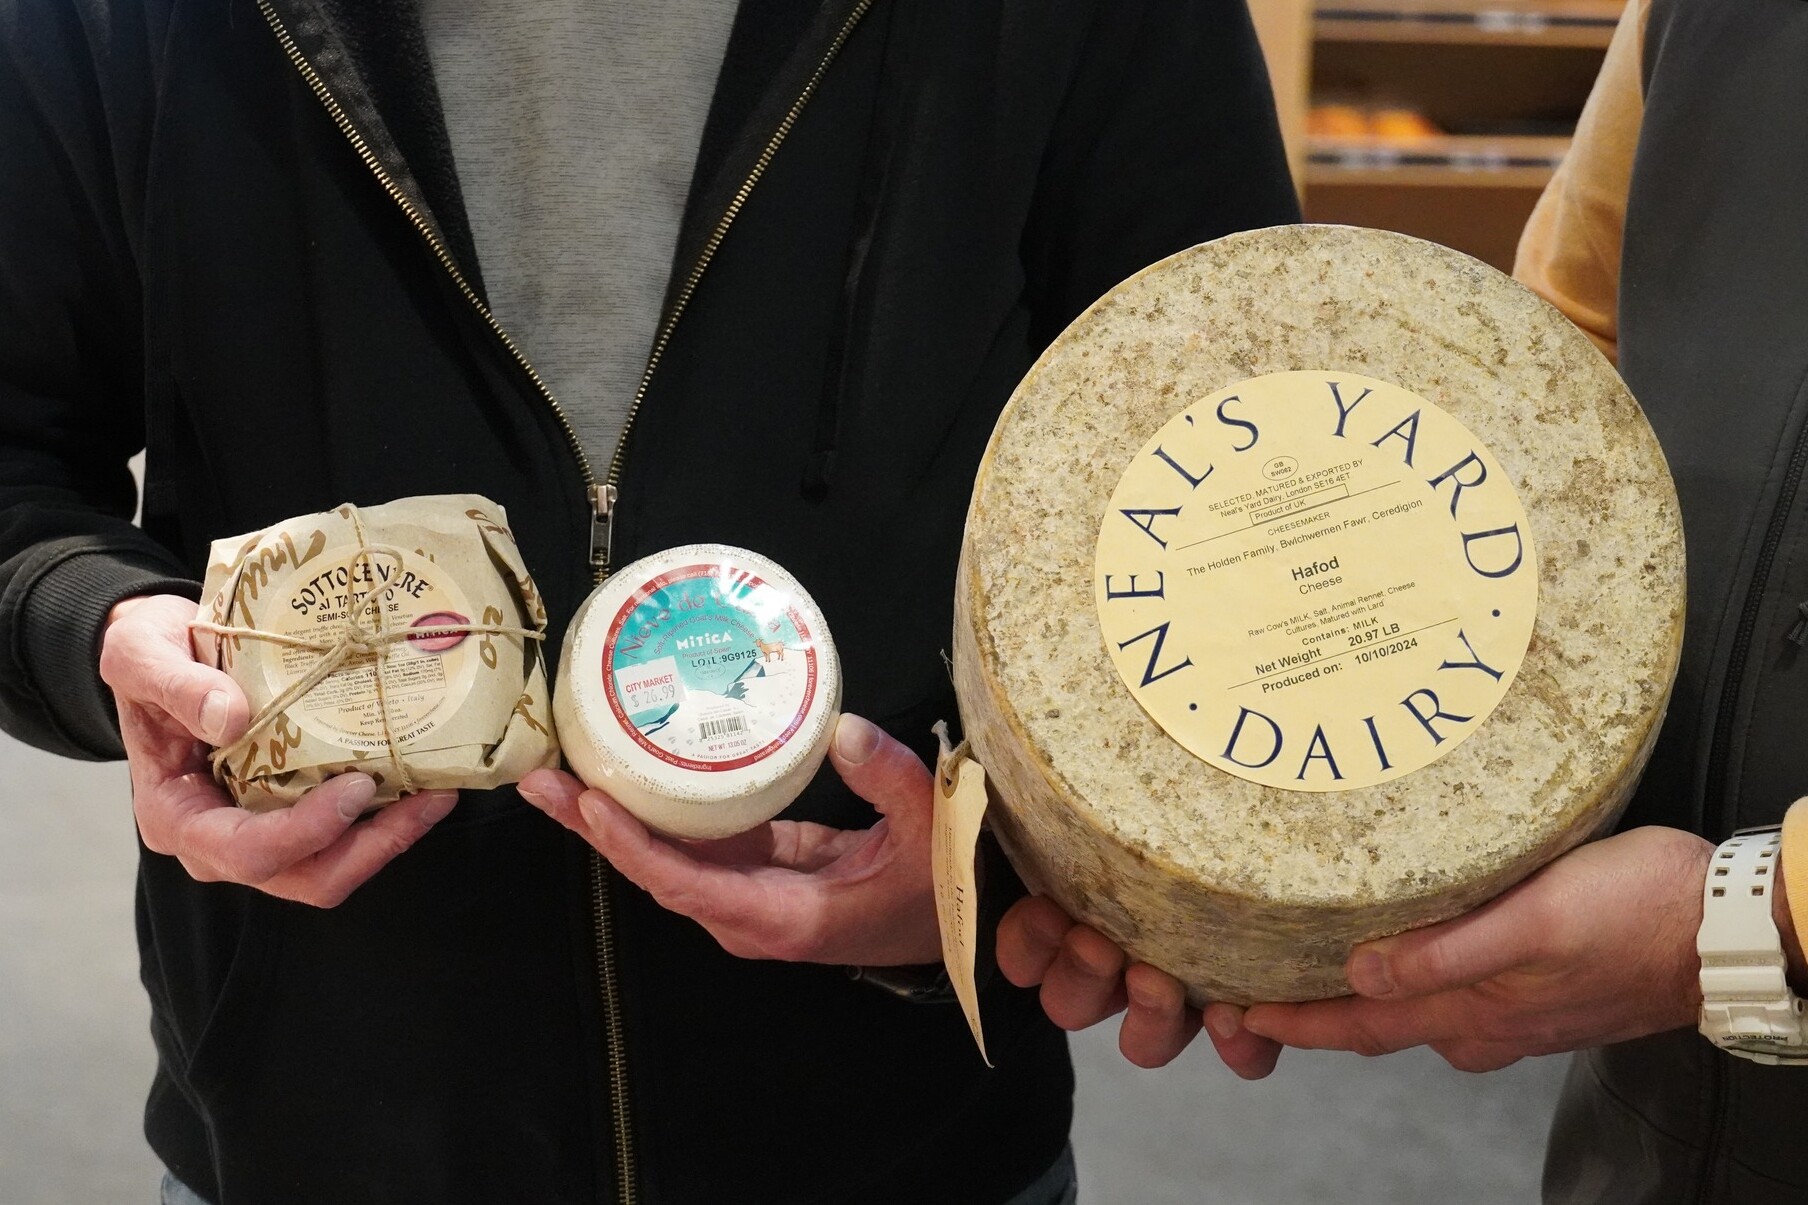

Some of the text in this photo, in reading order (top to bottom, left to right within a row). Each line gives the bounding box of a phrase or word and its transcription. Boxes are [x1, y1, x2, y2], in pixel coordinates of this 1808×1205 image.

[1273, 461, 1284, 469] GB
[1208, 493, 1255, 512] SELECTED,
[1256, 479, 1297, 497] MATURED
[1306, 463, 1351, 482] EXPORTED
[1353, 458, 1364, 468] BY
[1220, 506, 1243, 518] Neal's
[1244, 500, 1262, 511] Yard
[1286, 485, 1313, 498] London
[1314, 478, 1334, 489] SE16
[1335, 472, 1351, 483] 4ET
[1255, 499, 1306, 520] Product of UK
[1267, 511, 1330, 536] CHEESEMAKER
[1186, 499, 1423, 577] The Holden Family, Bwlchwernen Fawr, Ceredigion
[1105, 380, 1524, 781] NEAL'S YARD DAIRY
[1291, 556, 1340, 581] Hafod
[292, 562, 430, 616] SOTTOCENRE
[1299, 575, 1343, 595] Cheese
[318, 588, 394, 612] al TARTO
[365, 603, 399, 616] CHESE
[1247, 628, 1265, 637] Raw
[1266, 620, 1289, 632] Cow's
[1289, 613, 1312, 626] MILK,
[1331, 599, 1356, 612] Animal
[1357, 590, 1387, 606] Rennet,
[1387, 580, 1416, 595] Cheese
[620, 608, 670, 659] Nieve
[678, 592, 704, 611] de
[730, 619, 755, 638] Cheese
[1285, 601, 1385, 636] Cultures, Matured with Lard
[1301, 616, 1379, 646] Contains: MILK
[682, 651, 706, 659] Product
[1255, 622, 1401, 675] Net Weight 20.97 LB
[612, 696, 625, 719] Calcium
[626, 606, 635, 614] For
[1261, 637, 1418, 694] Produced on: 10/10/2024
[626, 674, 673, 693] CITY MARKET
[631, 684, 675, 708] $ 26.99
[338, 705, 365, 714] Product
[407, 694, 425, 702] Italy
[345, 739, 376, 747] PASSION
[416, 721, 435, 735] TASTE
